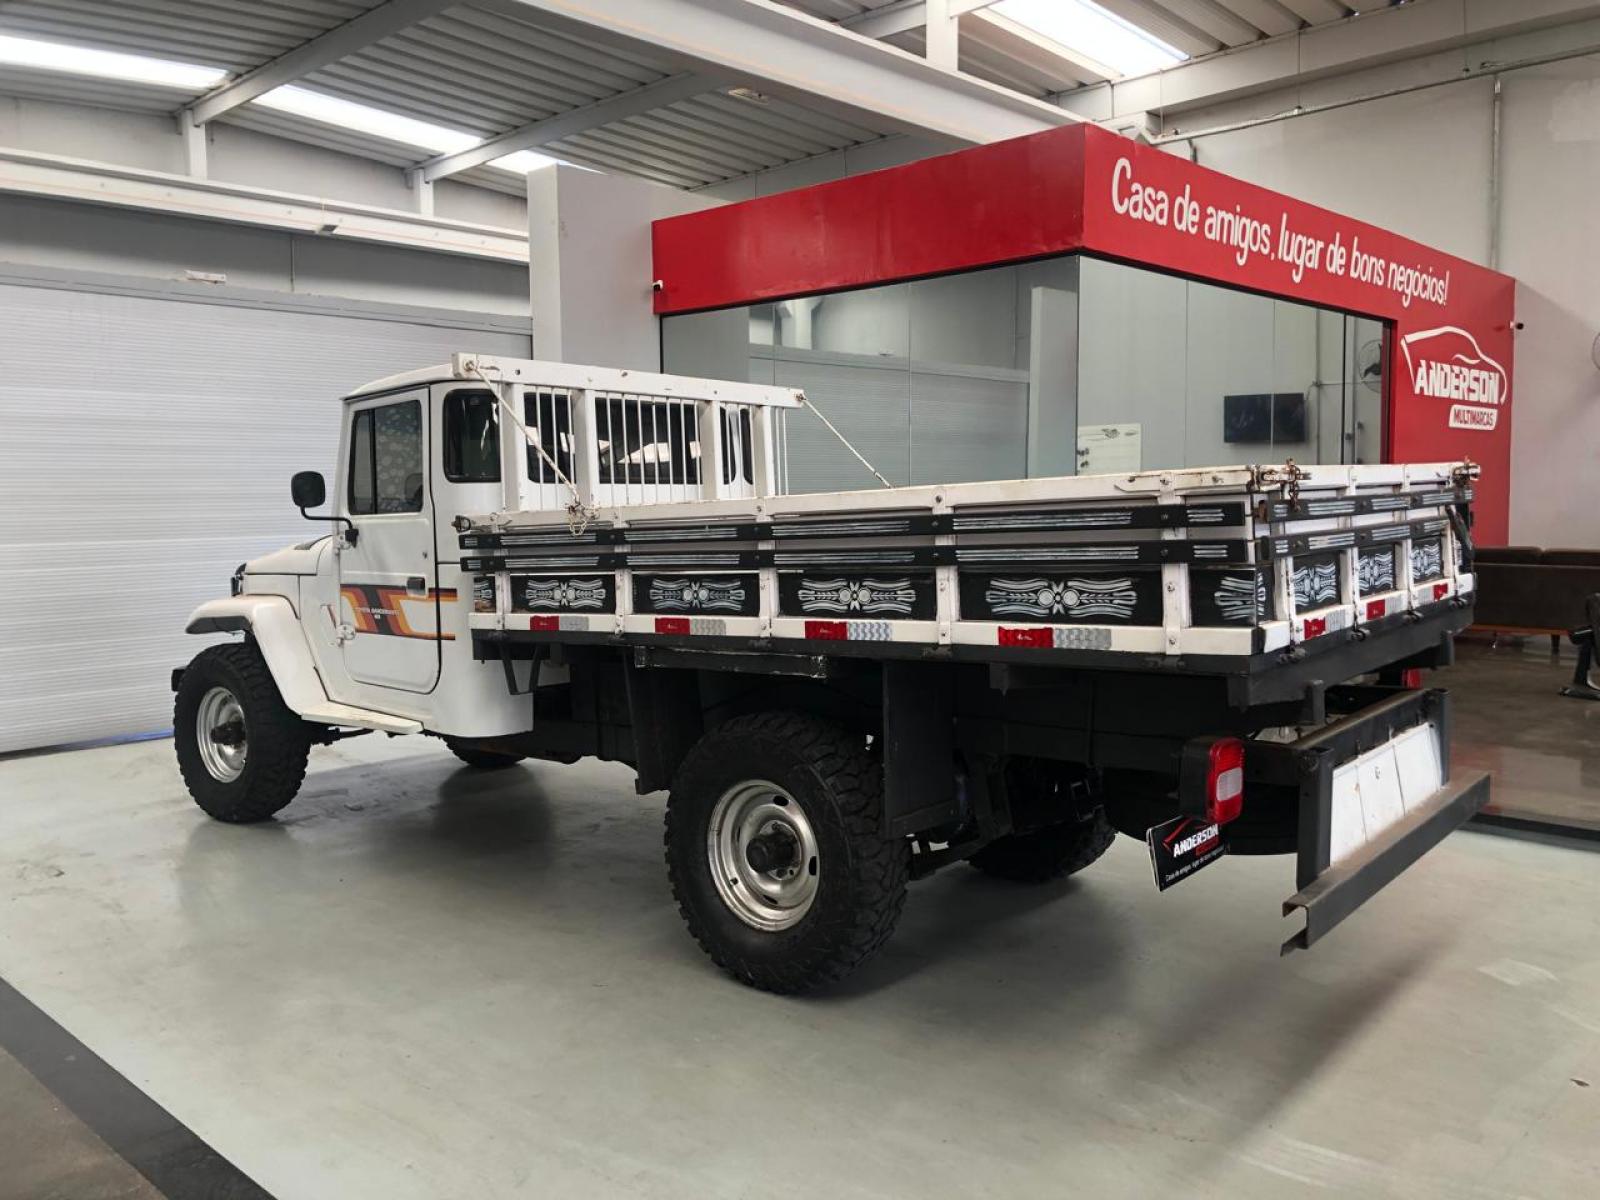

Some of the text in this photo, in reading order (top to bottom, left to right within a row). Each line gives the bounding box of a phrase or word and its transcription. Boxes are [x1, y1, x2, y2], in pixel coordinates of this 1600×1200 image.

[1111, 157, 1450, 308] Casa de amigos, lugar de bons negócios!
[1414, 359, 1500, 405] ANDERSON
[1453, 408, 1494, 427] MULTIMARCAS
[1173, 823, 1219, 858] ANDERSON
